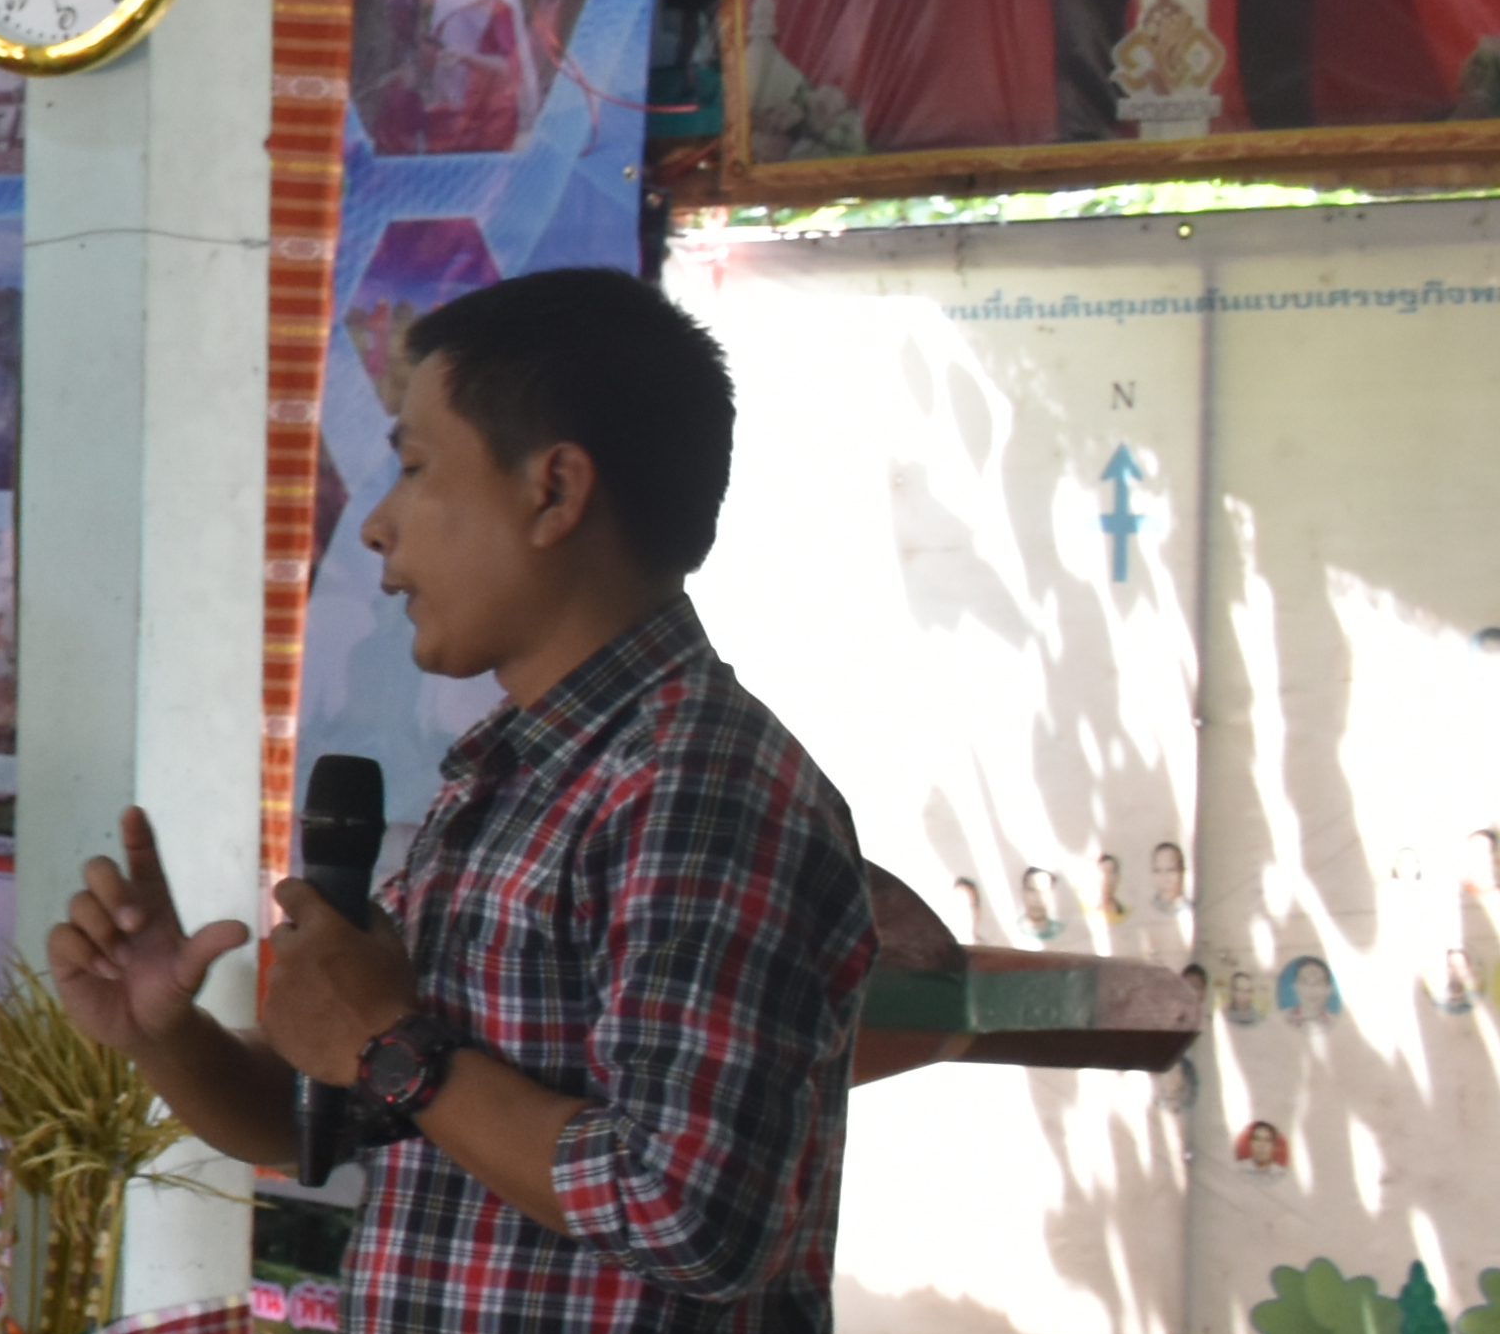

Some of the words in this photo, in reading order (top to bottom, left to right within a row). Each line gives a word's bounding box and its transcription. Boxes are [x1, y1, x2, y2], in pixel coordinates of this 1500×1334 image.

[941, 280, 1500, 324] นที่เดินดินชุมชนต้นแบบเศรษฐกิจพ
[1110, 382, 1137, 410] N
